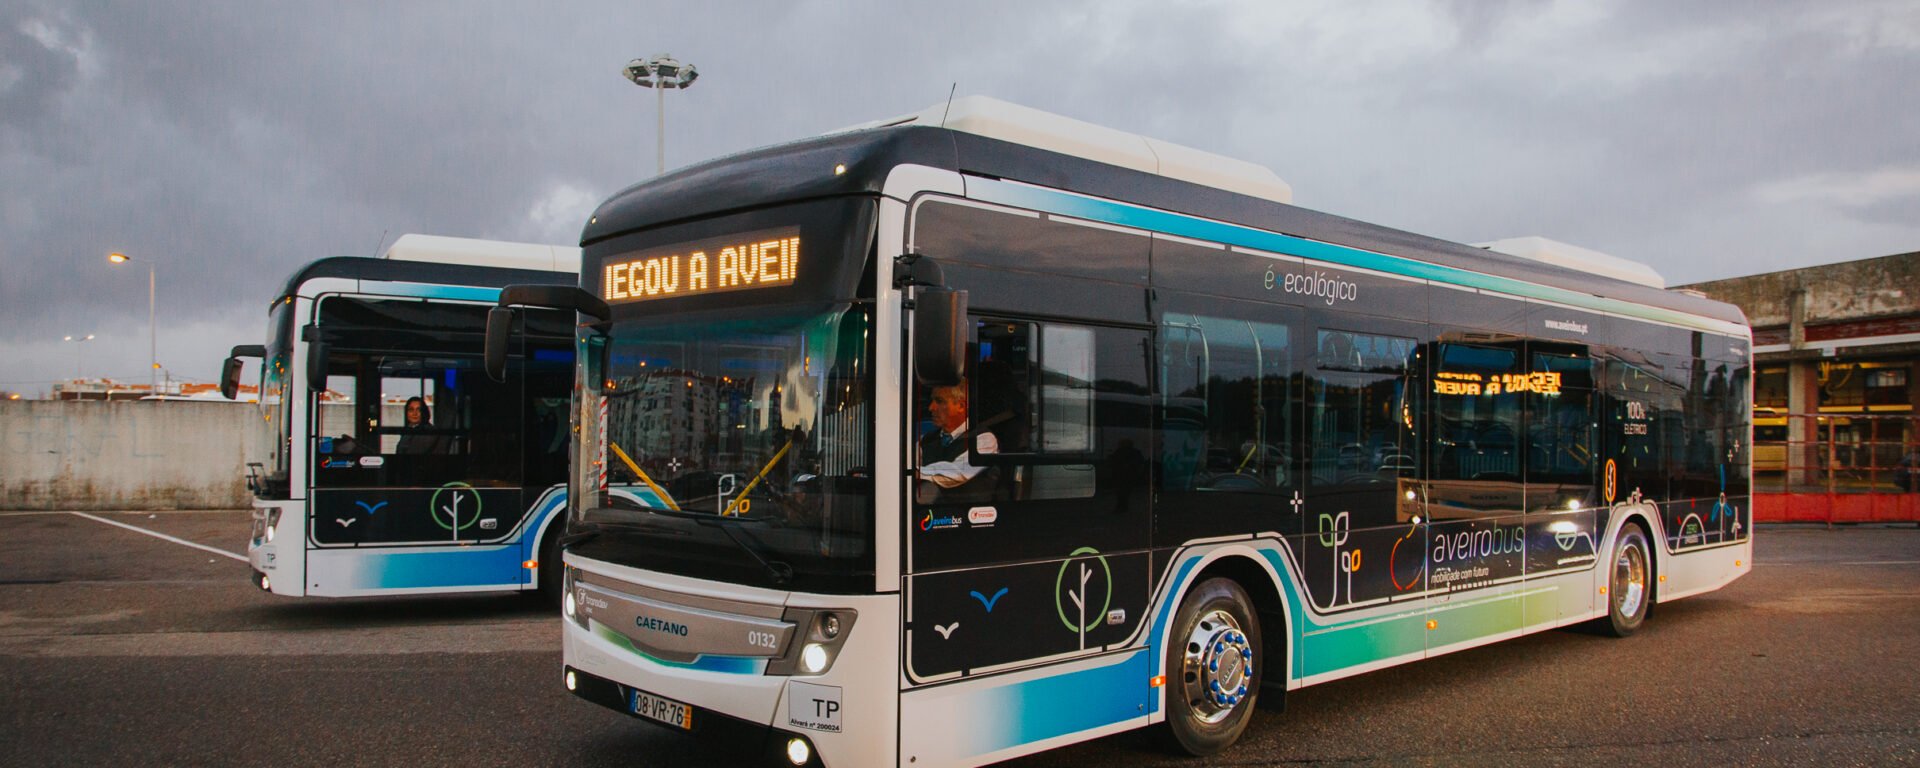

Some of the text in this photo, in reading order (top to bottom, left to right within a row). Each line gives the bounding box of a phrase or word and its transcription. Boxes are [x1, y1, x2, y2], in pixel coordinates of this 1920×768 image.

[689, 251, 707, 290] A
[1433, 519, 1525, 563] aveirobus
[636, 615, 688, 637] CAETANO
[748, 630, 776, 649] 0132
[812, 698, 840, 719] TP
[816, 723, 840, 731] 200024
